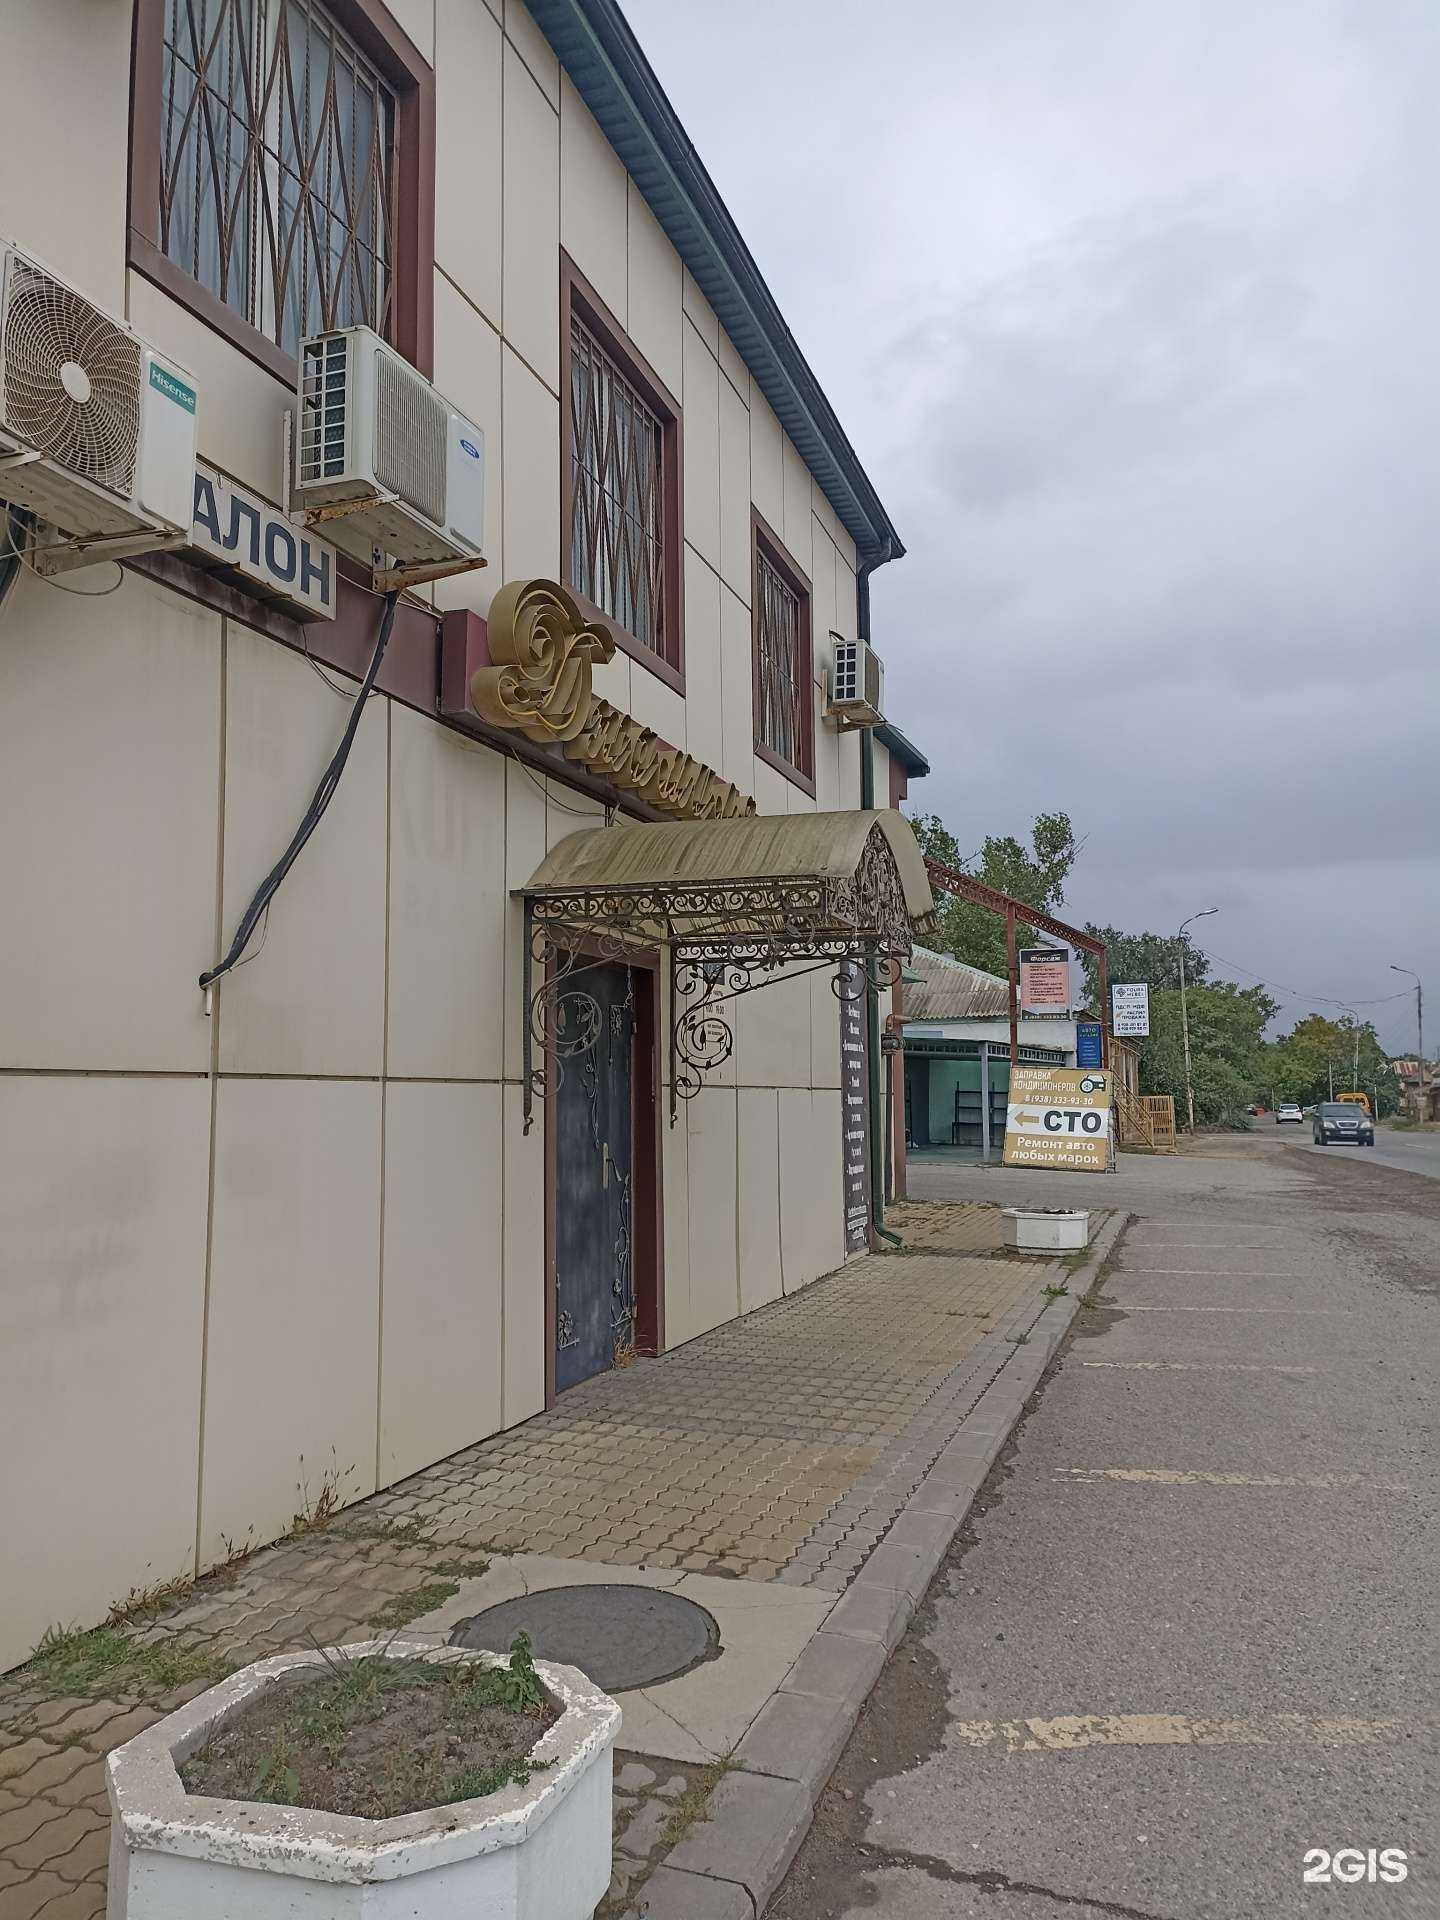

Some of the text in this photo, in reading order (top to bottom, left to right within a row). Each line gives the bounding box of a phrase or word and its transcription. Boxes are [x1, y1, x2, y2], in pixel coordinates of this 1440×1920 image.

[151, 369, 195, 406] Hisense
[193, 472, 330, 606] АЛОН
[1014, 1070, 1052, 1080] ЗАПРАВКА
[1013, 1080, 1076, 1092] КОНДИЦИОНЕРОВ
[1031, 1095, 1052, 1104] (938)
[1053, 1096, 1094, 1105] 333-93-30
[1044, 1110, 1102, 1133] СТО
[1017, 1136, 1095, 1151] Ремонт авто
[1011, 1149, 1099, 1165] любых марок
